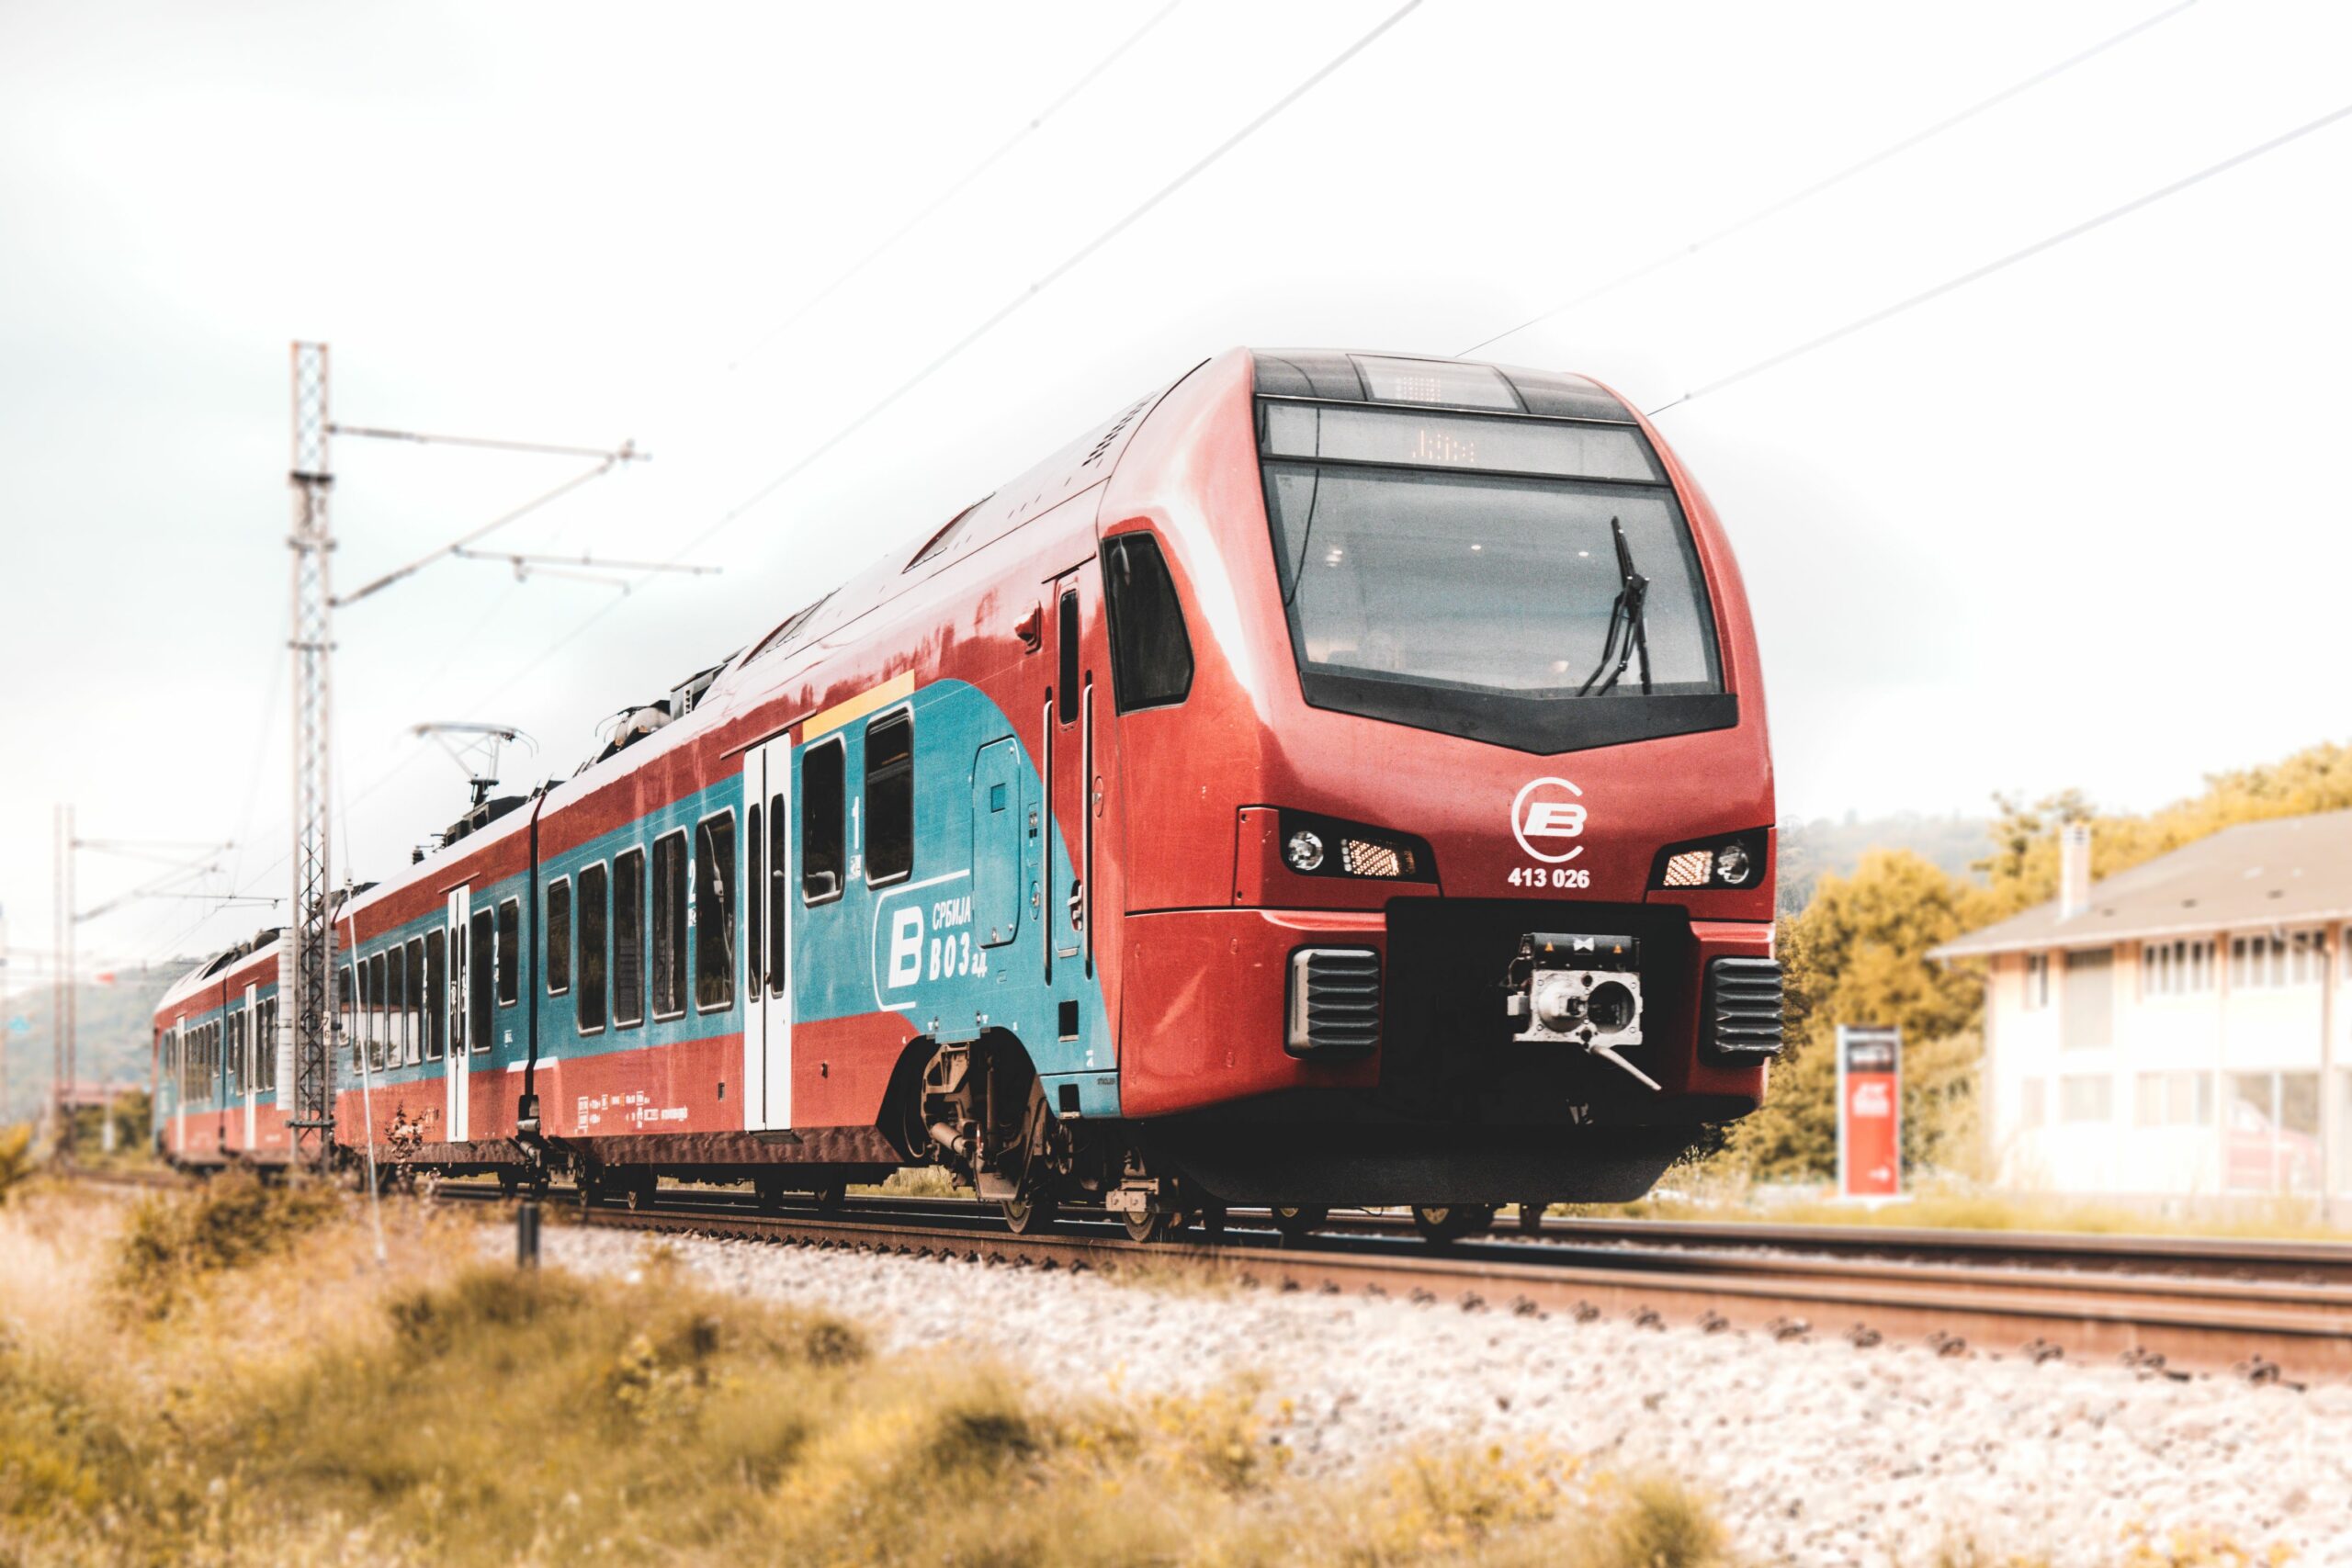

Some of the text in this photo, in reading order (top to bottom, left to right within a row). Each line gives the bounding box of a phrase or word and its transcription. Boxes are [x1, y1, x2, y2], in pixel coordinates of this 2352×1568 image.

[852, 795, 860, 850] 1
[1507, 867, 1590, 888] 413 026
[933, 896, 971, 931] СРБИЈА
